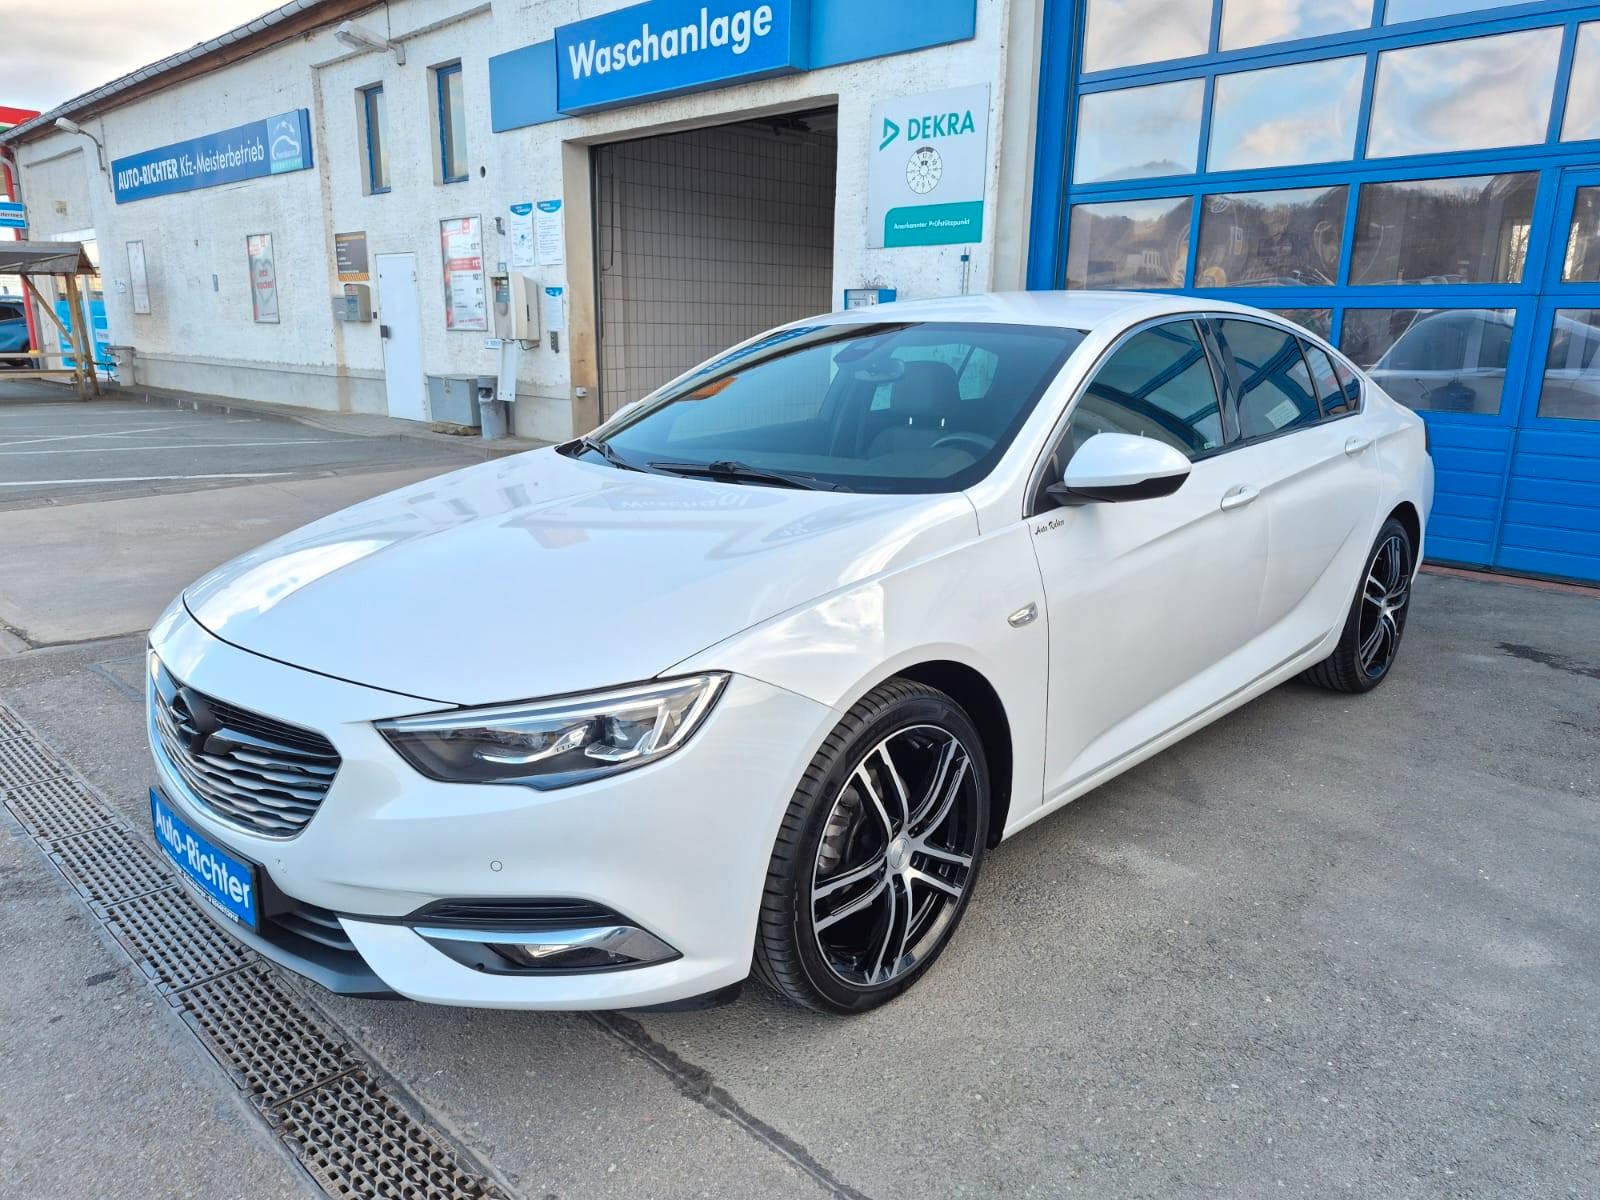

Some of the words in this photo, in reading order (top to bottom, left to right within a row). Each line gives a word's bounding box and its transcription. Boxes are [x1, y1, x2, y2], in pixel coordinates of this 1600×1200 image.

[568, 4, 773, 80] Waschanlage
[907, 110, 976, 142] DEKRA
[118, 158, 179, 191] AUTO-RICHTER
[179, 136, 265, 178] Kfz-Meisterbetrieb
[155, 801, 250, 909] Auto-Richter
